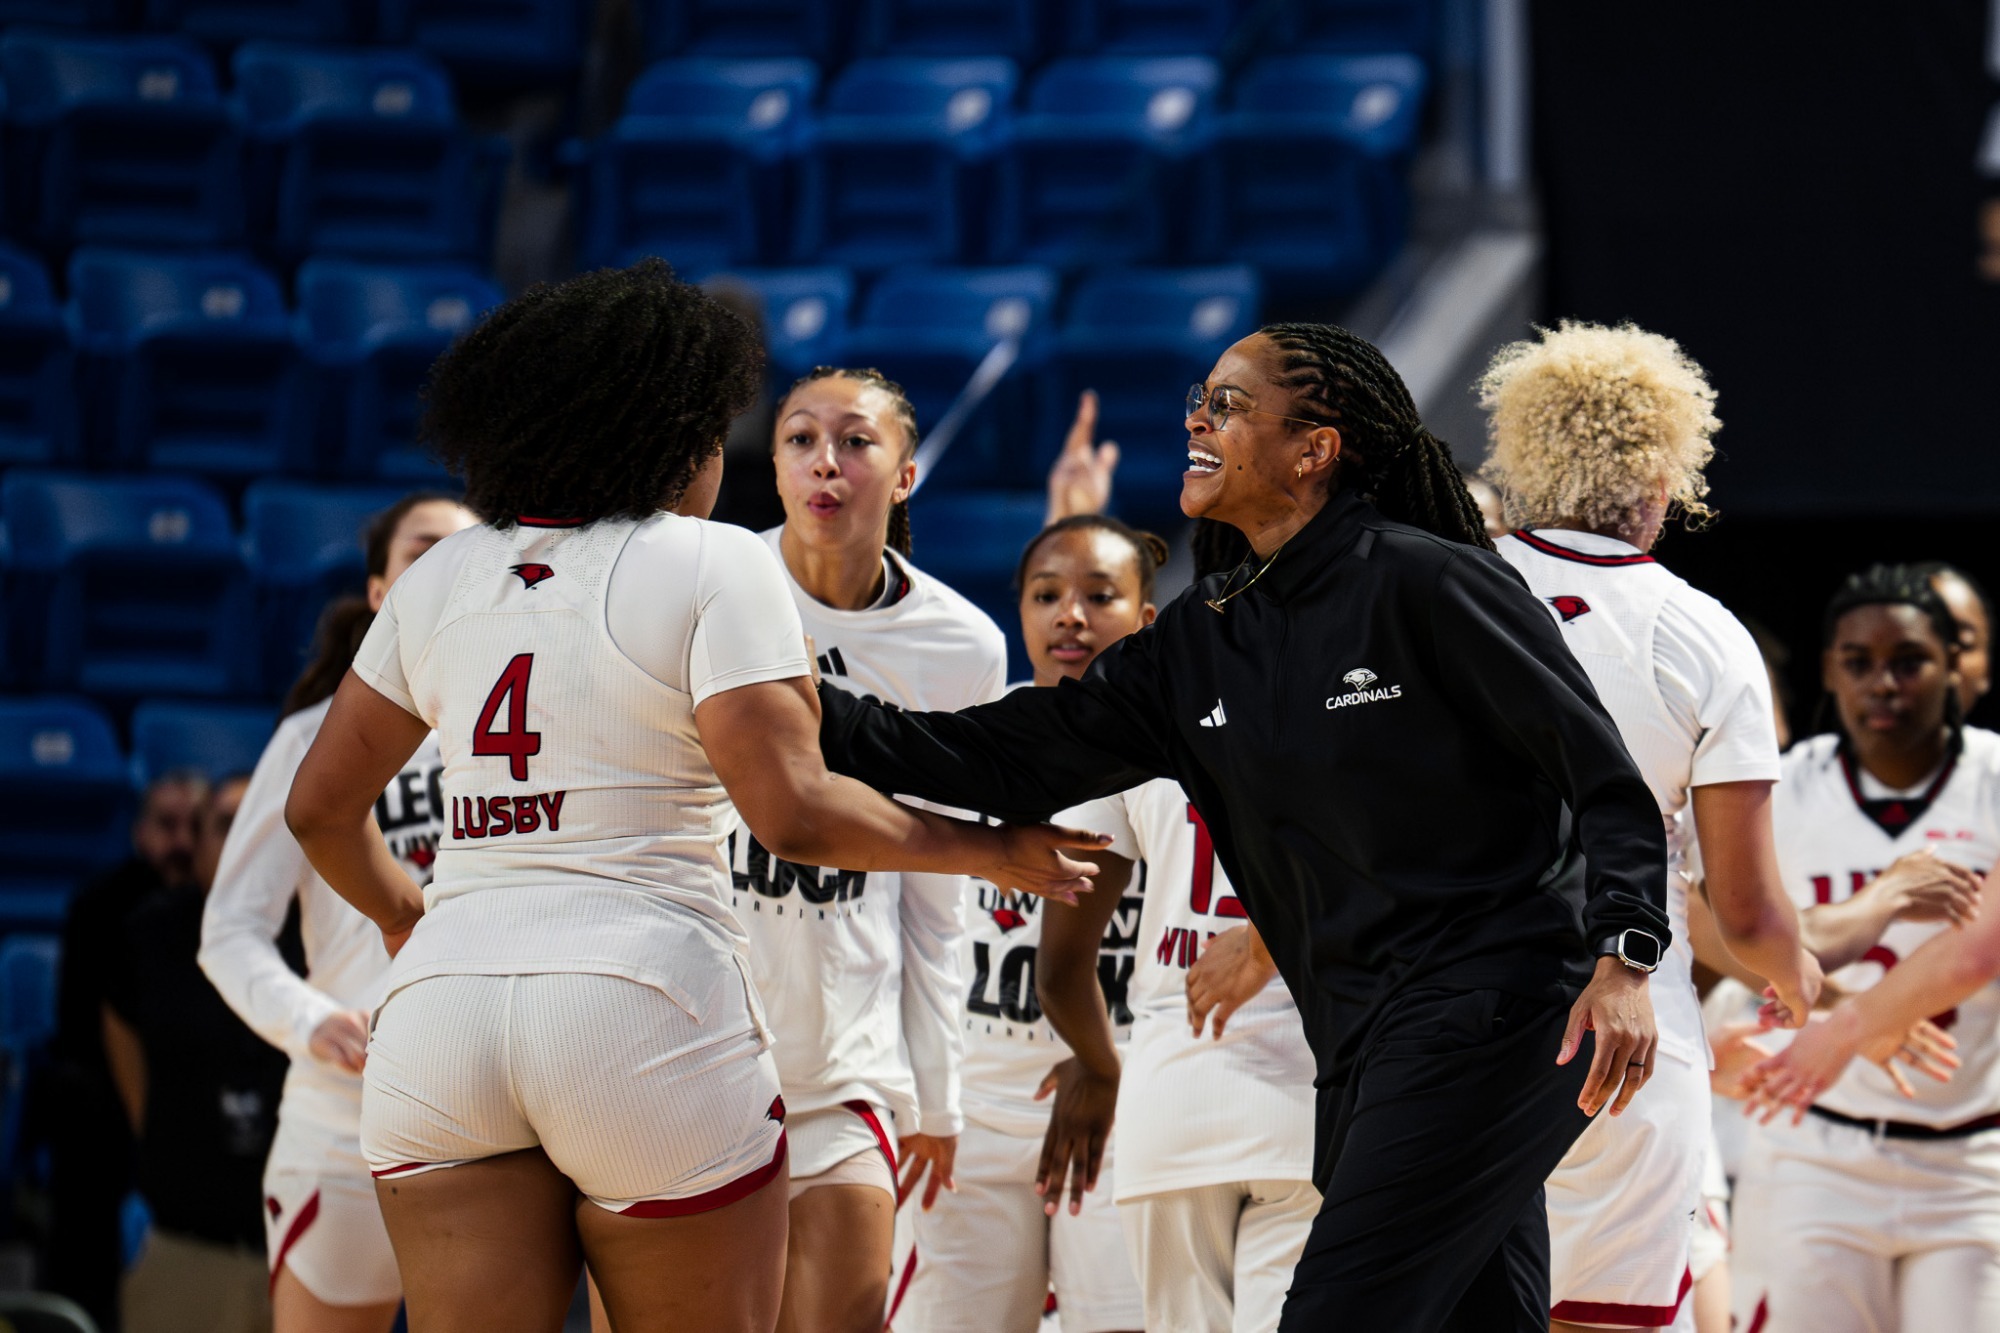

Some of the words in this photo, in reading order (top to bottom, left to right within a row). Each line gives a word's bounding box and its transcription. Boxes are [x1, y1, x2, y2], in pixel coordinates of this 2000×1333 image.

[472, 653, 541, 782] 4
[1325, 684, 1402, 710] CARDINALS
[453, 790, 566, 840] LUSBY
